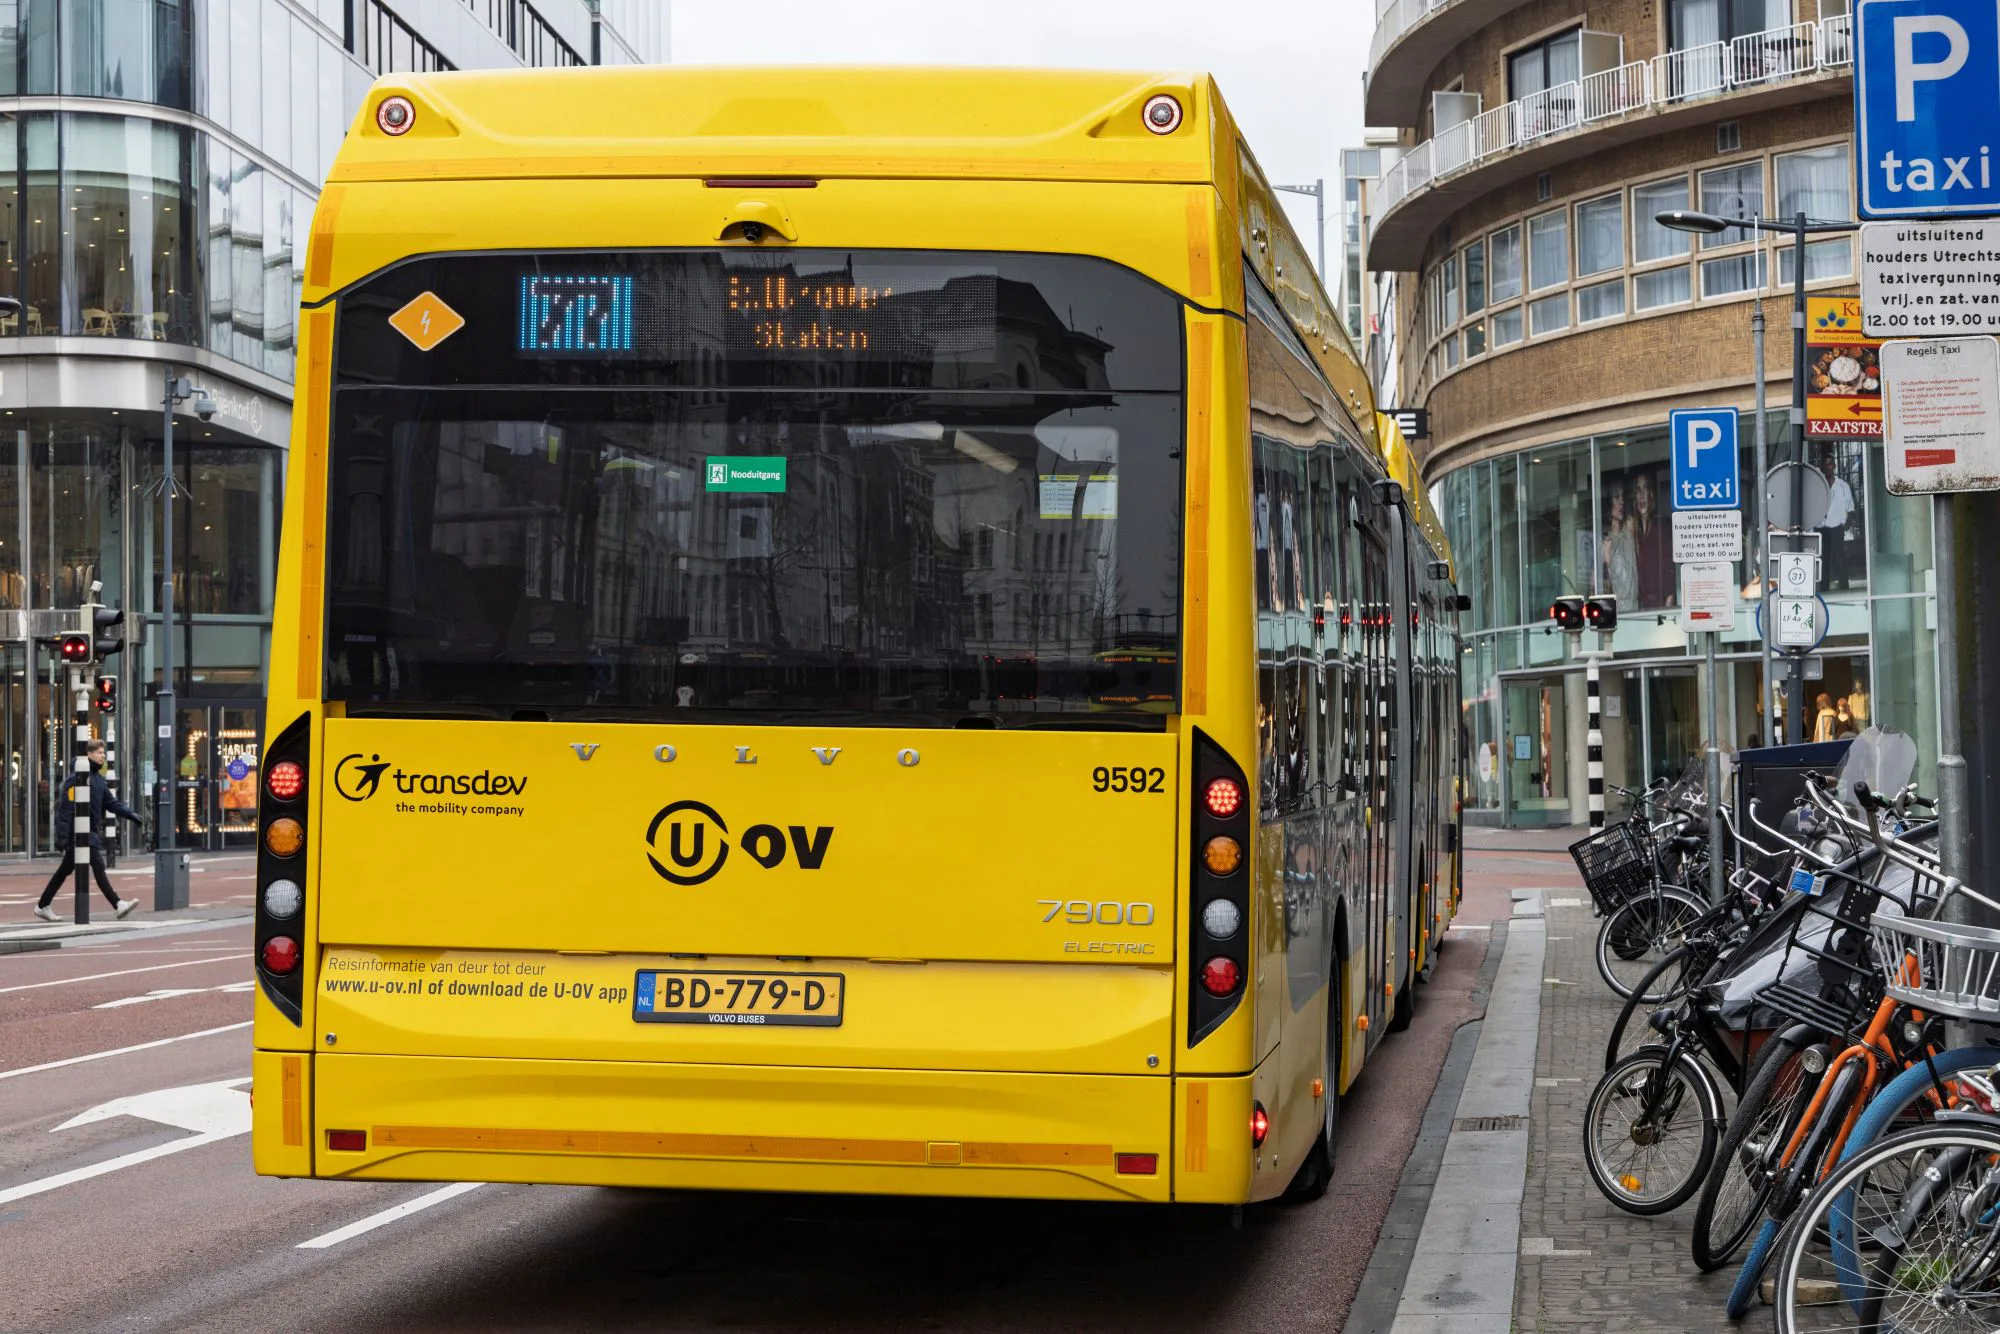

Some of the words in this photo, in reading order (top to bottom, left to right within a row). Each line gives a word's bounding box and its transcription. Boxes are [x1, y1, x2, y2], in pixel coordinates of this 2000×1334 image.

[1893, 14, 1970, 122] P
[1880, 145, 1991, 193] taxi
[1896, 229, 1984, 241] uitsluitend
[1866, 251, 1928, 263] houders
[1879, 271, 2000, 287] taxivergunning
[1867, 314, 1909, 326] 12.00
[1913, 314, 1936, 326] tot
[1940, 313, 1982, 326] 19.00
[1906, 346, 1937, 357] Regels
[1941, 345, 1961, 354] Taxi
[1687, 419, 1722, 468] P
[730, 470, 781, 480] Nooduitgang
[1681, 477, 1731, 499] taxi
[1680, 532, 1735, 540] taxivergunning
[1791, 572, 1802, 580] 31
[569, 743, 921, 767] VOLVO
[393, 768, 528, 796] transdev
[1092, 766, 1165, 793] 9592
[395, 802, 415, 813] the
[418, 802, 468, 816] mobility
[470, 805, 525, 817] company
[1036, 899, 1155, 925] 7900
[1063, 941, 1155, 955] ELECTRIC
[328, 957, 426, 973] Reisinformatie
[430, 962, 453, 973] van
[458, 960, 488, 975] deur
[493, 961, 511, 975] tot
[515, 961, 547, 976] deur
[325, 978, 422, 994] www.u-ov.nl
[428, 979, 444, 995] of
[448, 980, 524, 998] download
[529, 980, 547, 998] de
[554, 982, 594, 999] U-OV
[598, 987, 628, 1004] app
[665, 977, 825, 1011] BD-779-D
[638, 996, 652, 1006] NL
[708, 1014, 736, 1023] VOLVO
[737, 1014, 765, 1024] BUSES
